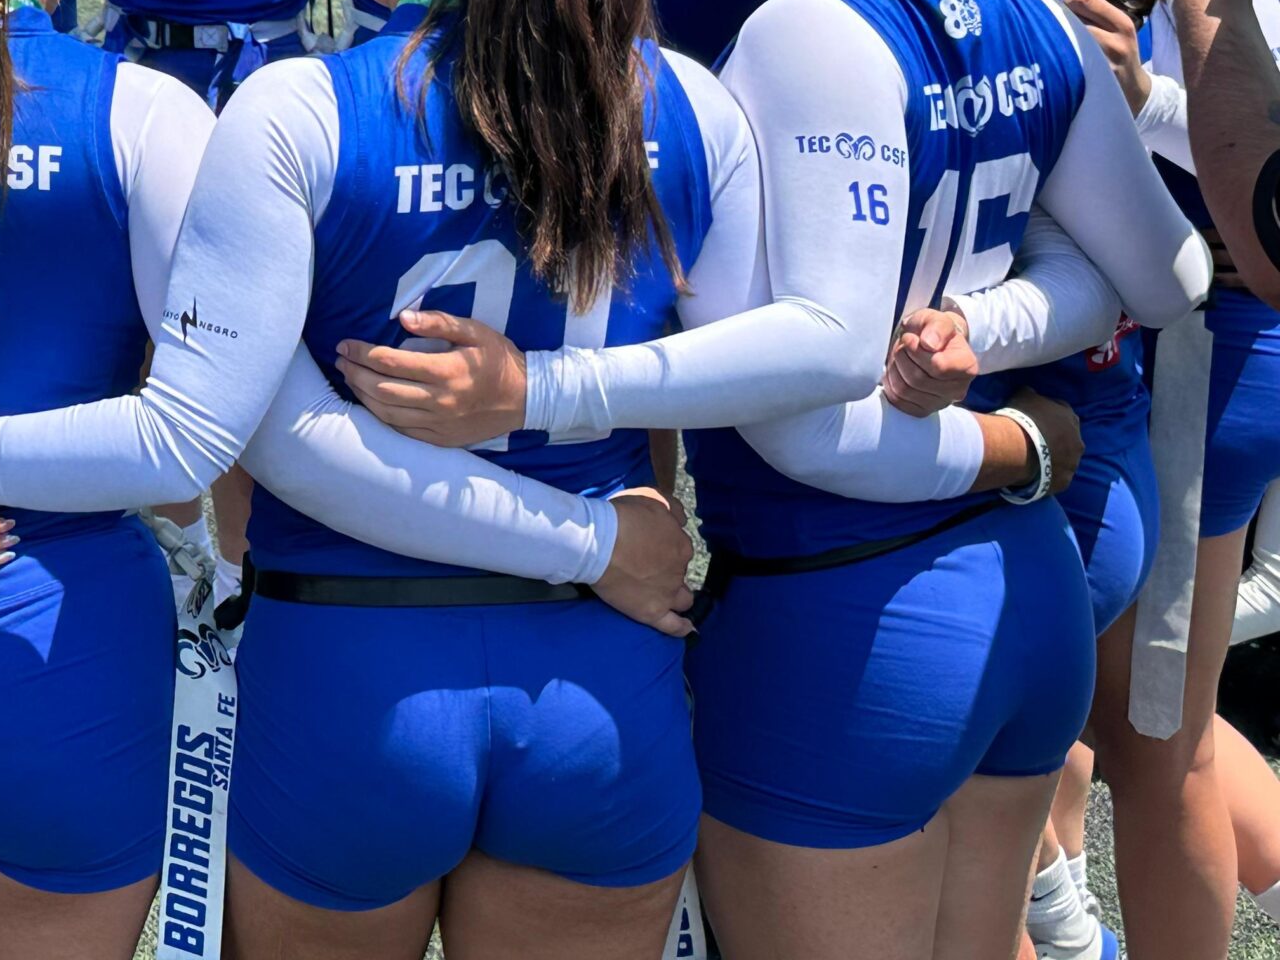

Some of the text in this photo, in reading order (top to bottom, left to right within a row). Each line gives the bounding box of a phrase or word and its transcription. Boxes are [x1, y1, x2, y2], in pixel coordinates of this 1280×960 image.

[795, 135, 906, 168] TEC CSF
[394, 162, 475, 214] TEC
[848, 181, 890, 226] 16
[199, 320, 239, 339] NEGRO
[212, 692, 236, 791] SANTA FE
[164, 724, 216, 957] BORREGOS
